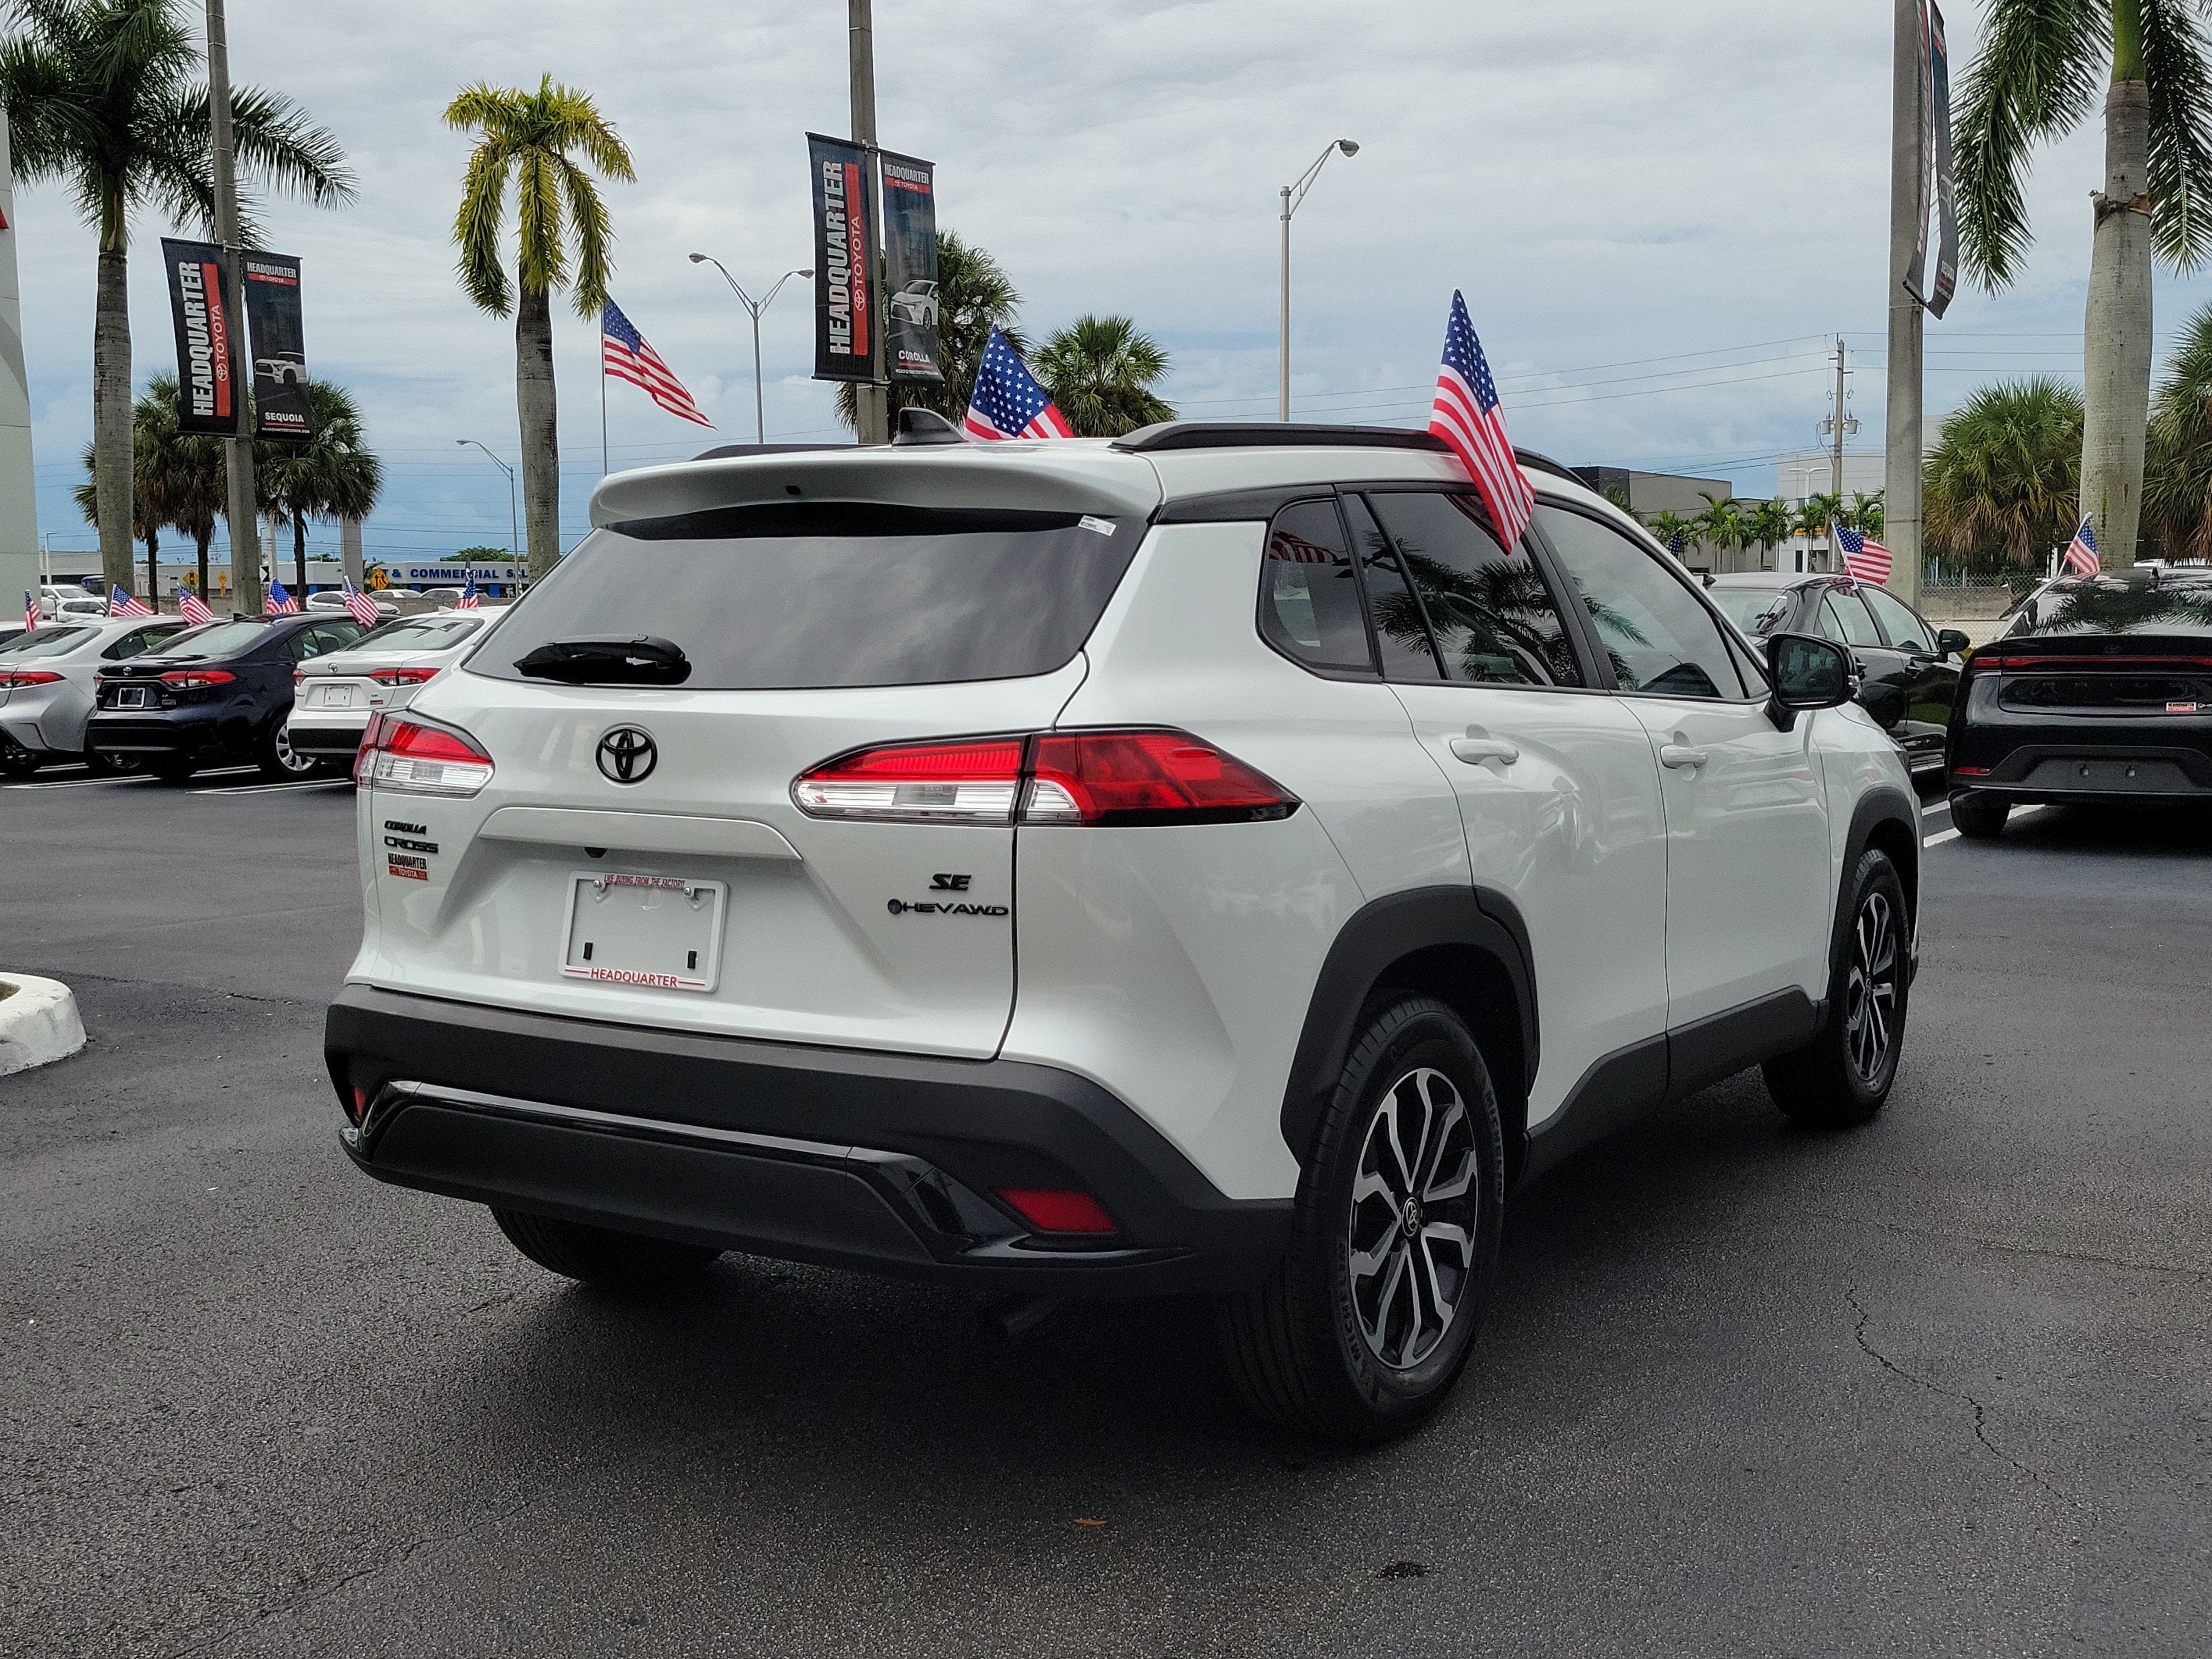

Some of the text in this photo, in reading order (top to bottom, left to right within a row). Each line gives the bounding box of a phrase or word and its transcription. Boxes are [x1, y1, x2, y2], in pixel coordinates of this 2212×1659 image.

[884, 163, 929, 184] HEADQUARTER
[823, 161, 851, 354] HEADQUARTER
[851, 216, 864, 287] TOYOTA
[247, 262, 296, 278] HEADQUARTER
[179, 262, 214, 416] HEADQUARTER
[212, 304, 226, 362] TOYOTA
[899, 350, 930, 363] COROLLA
[265, 412, 304, 422] SEQUOIA
[392, 569, 402, 577] &
[384, 836, 438, 853] CROSS
[388, 853, 427, 870] HEADQUARTER
[929, 874, 972, 890] SE
[591, 968, 678, 986] HEADQUARTER
